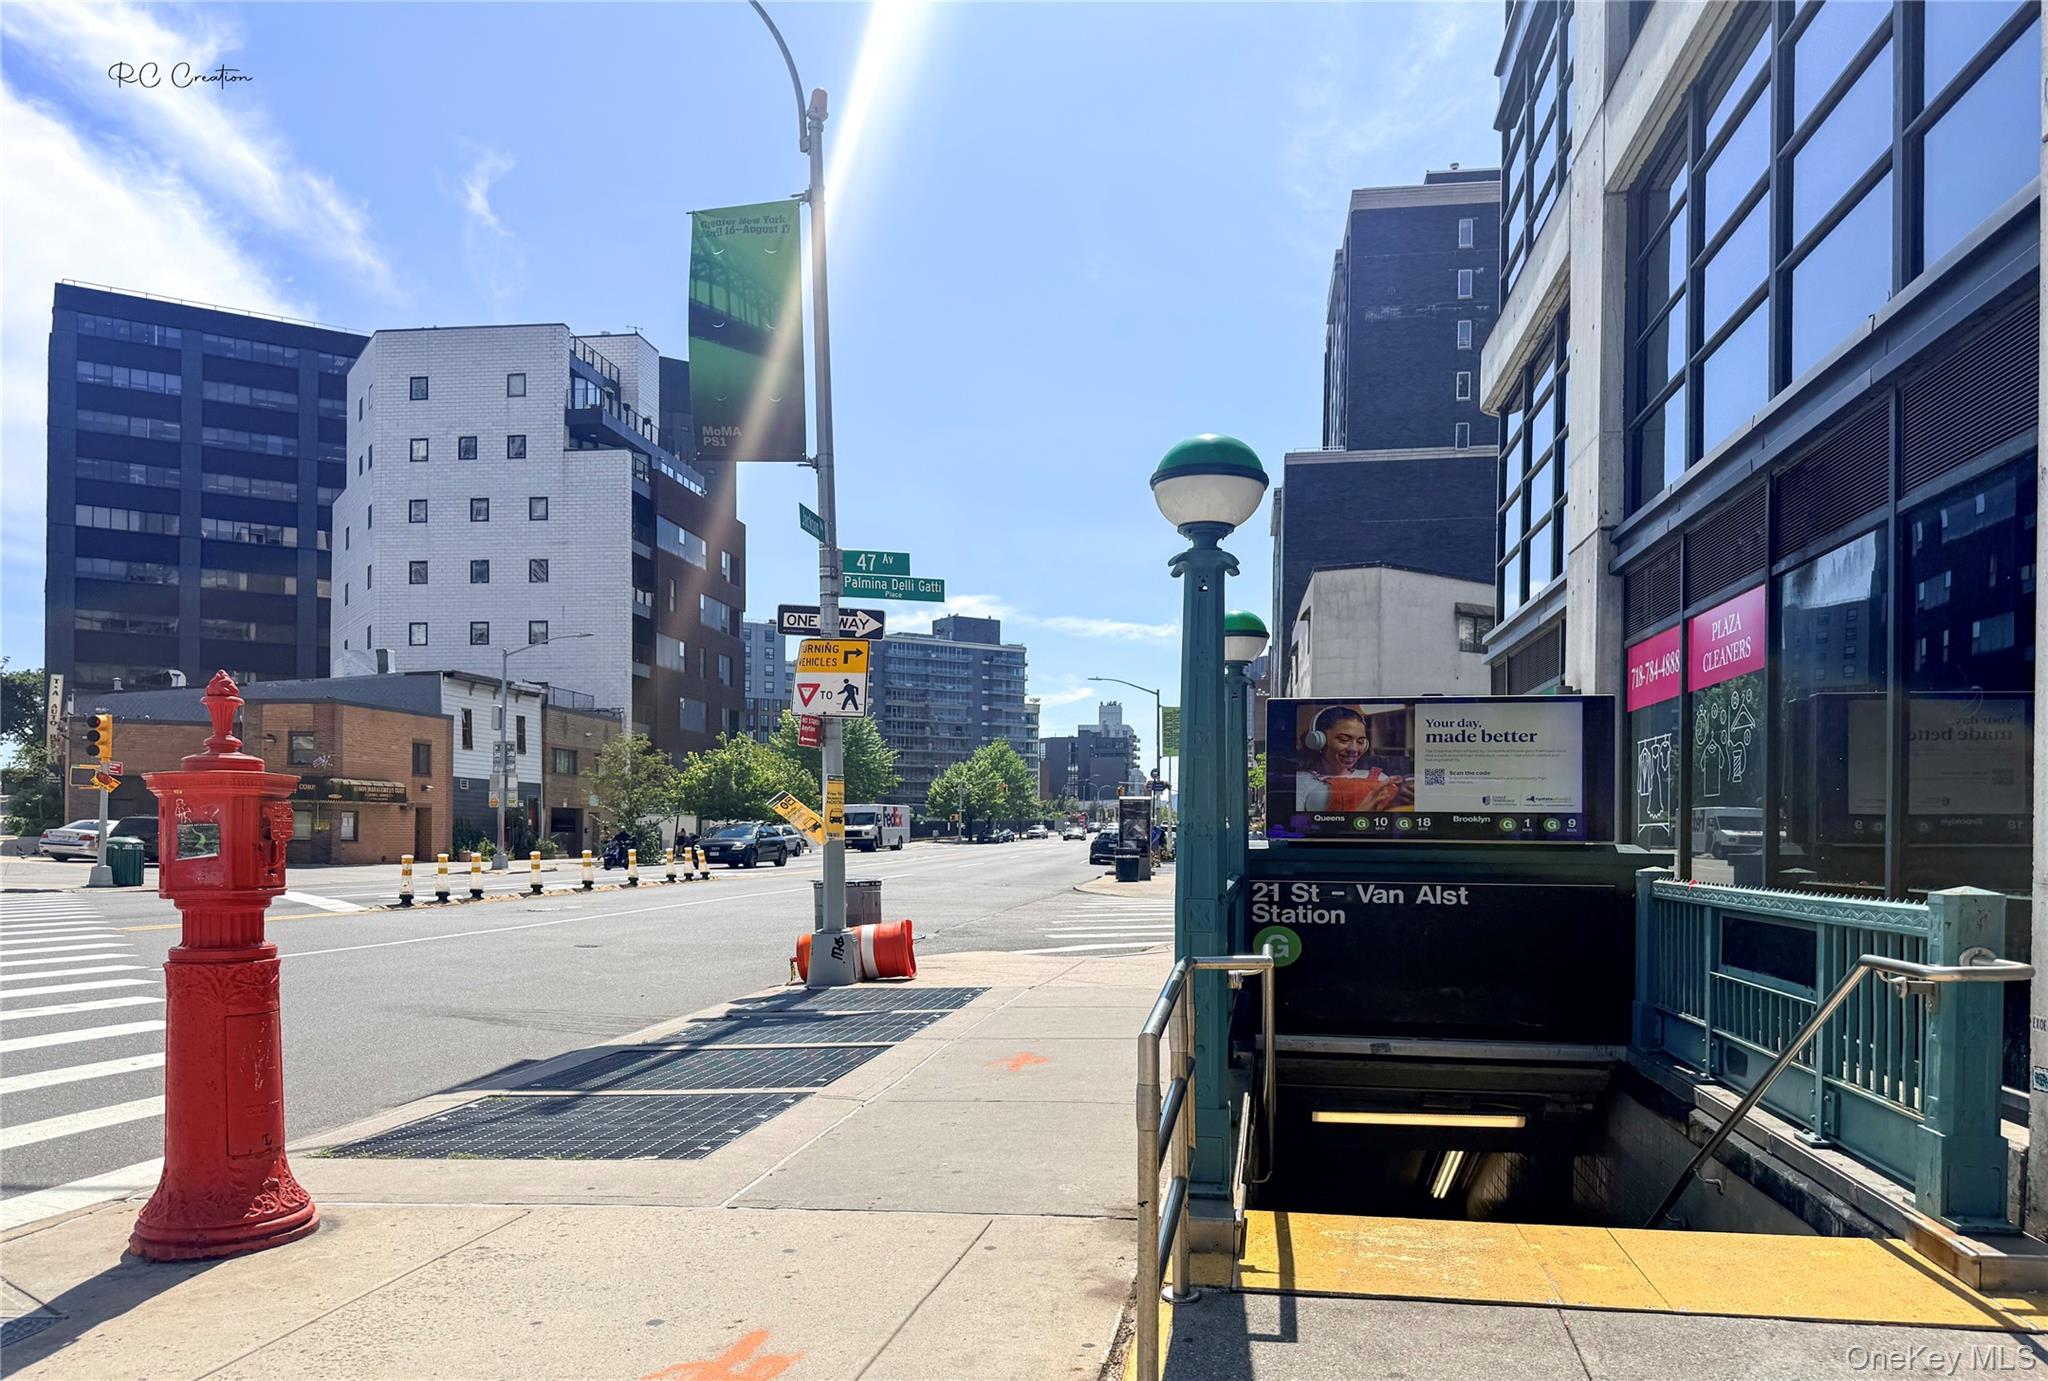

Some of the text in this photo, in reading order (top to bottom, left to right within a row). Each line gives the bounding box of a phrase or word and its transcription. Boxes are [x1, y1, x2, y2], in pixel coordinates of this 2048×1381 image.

[739, 217, 760, 225] New
[763, 215, 786, 224] York
[702, 425, 742, 437] MoMA
[703, 436, 728, 447] PS1
[856, 553, 894, 571] 47 Av
[844, 575, 942, 593] Palmina Delli Gatti
[885, 590, 902, 598] Place
[786, 614, 818, 627] ONE
[1711, 611, 1742, 642] PLAZA
[802, 644, 839, 654] URNING
[1702, 636, 1751, 673] CLEANERS
[1631, 649, 1680, 691] 718-784-4888
[820, 690, 833, 700] TO
[1425, 718, 1482, 730] Your day,
[1425, 729, 1538, 743] made better
[883, 806, 902, 827] FedEx
[1314, 814, 1576, 829] Queens G 10 G 18 Brooklyn G 1 G 9
[1252, 883, 1279, 902] 21
[1291, 883, 1320, 903] St
[1356, 884, 1404, 904] Van
[1415, 885, 1469, 905] Alst
[1251, 903, 1346, 924] Station
[1265, 934, 1289, 958] G
